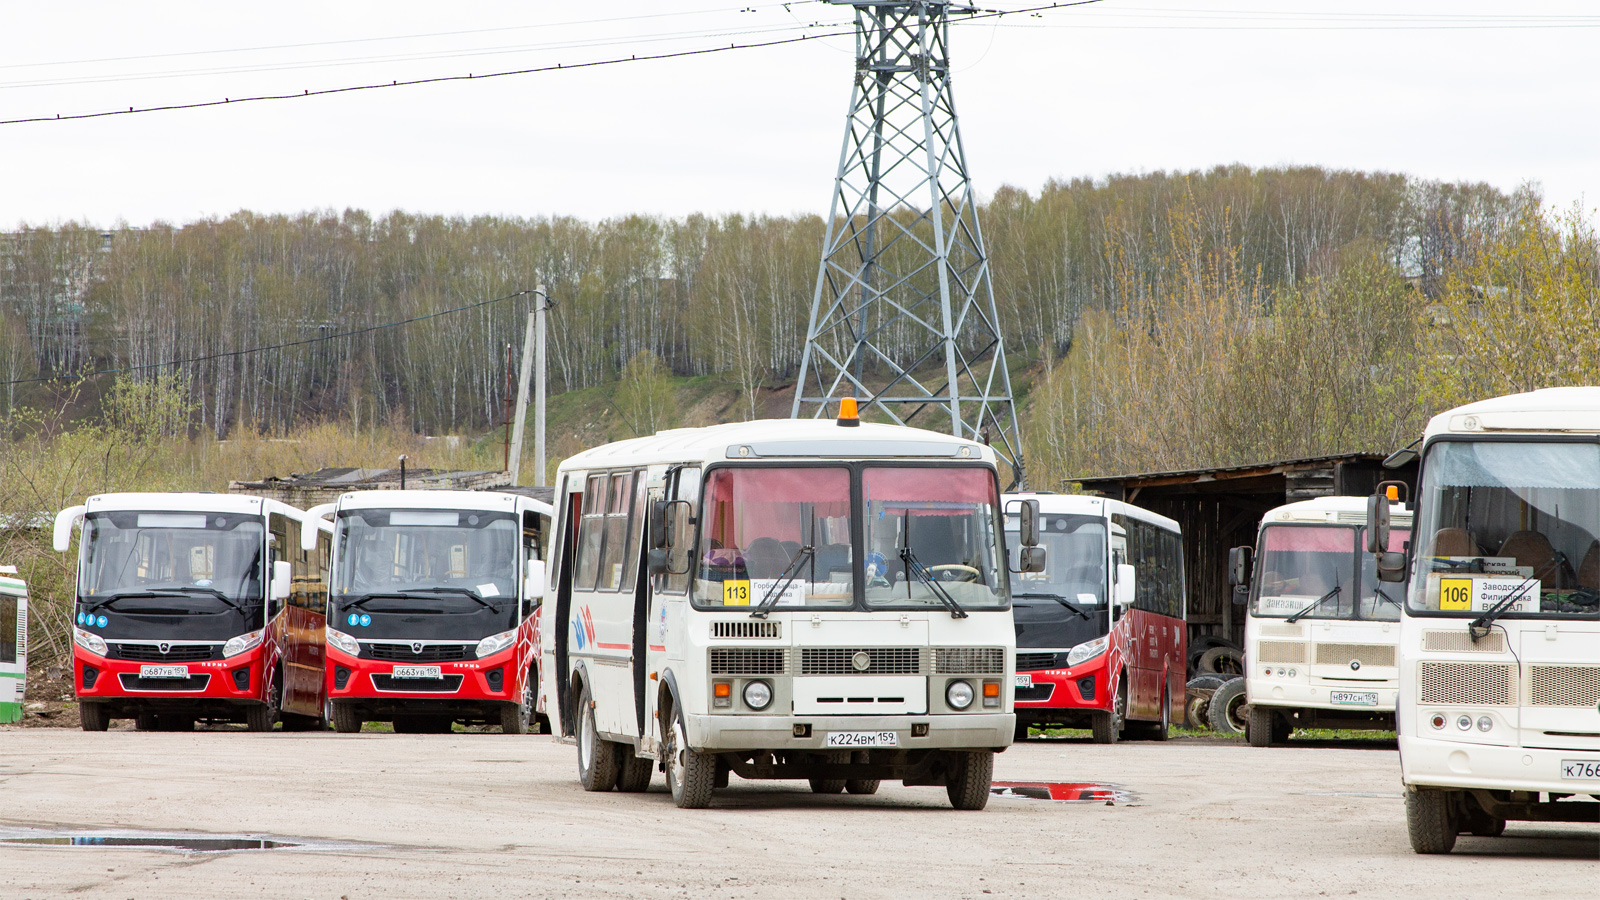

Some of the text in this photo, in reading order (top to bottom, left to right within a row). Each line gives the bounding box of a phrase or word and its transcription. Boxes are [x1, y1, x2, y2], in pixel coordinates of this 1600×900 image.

[726, 586, 747, 599] 113
[1443, 587, 1468, 602] 106
[1482, 603, 1523, 611] ВОАЛ
[830, 732, 894, 745] К224ВМ 159
